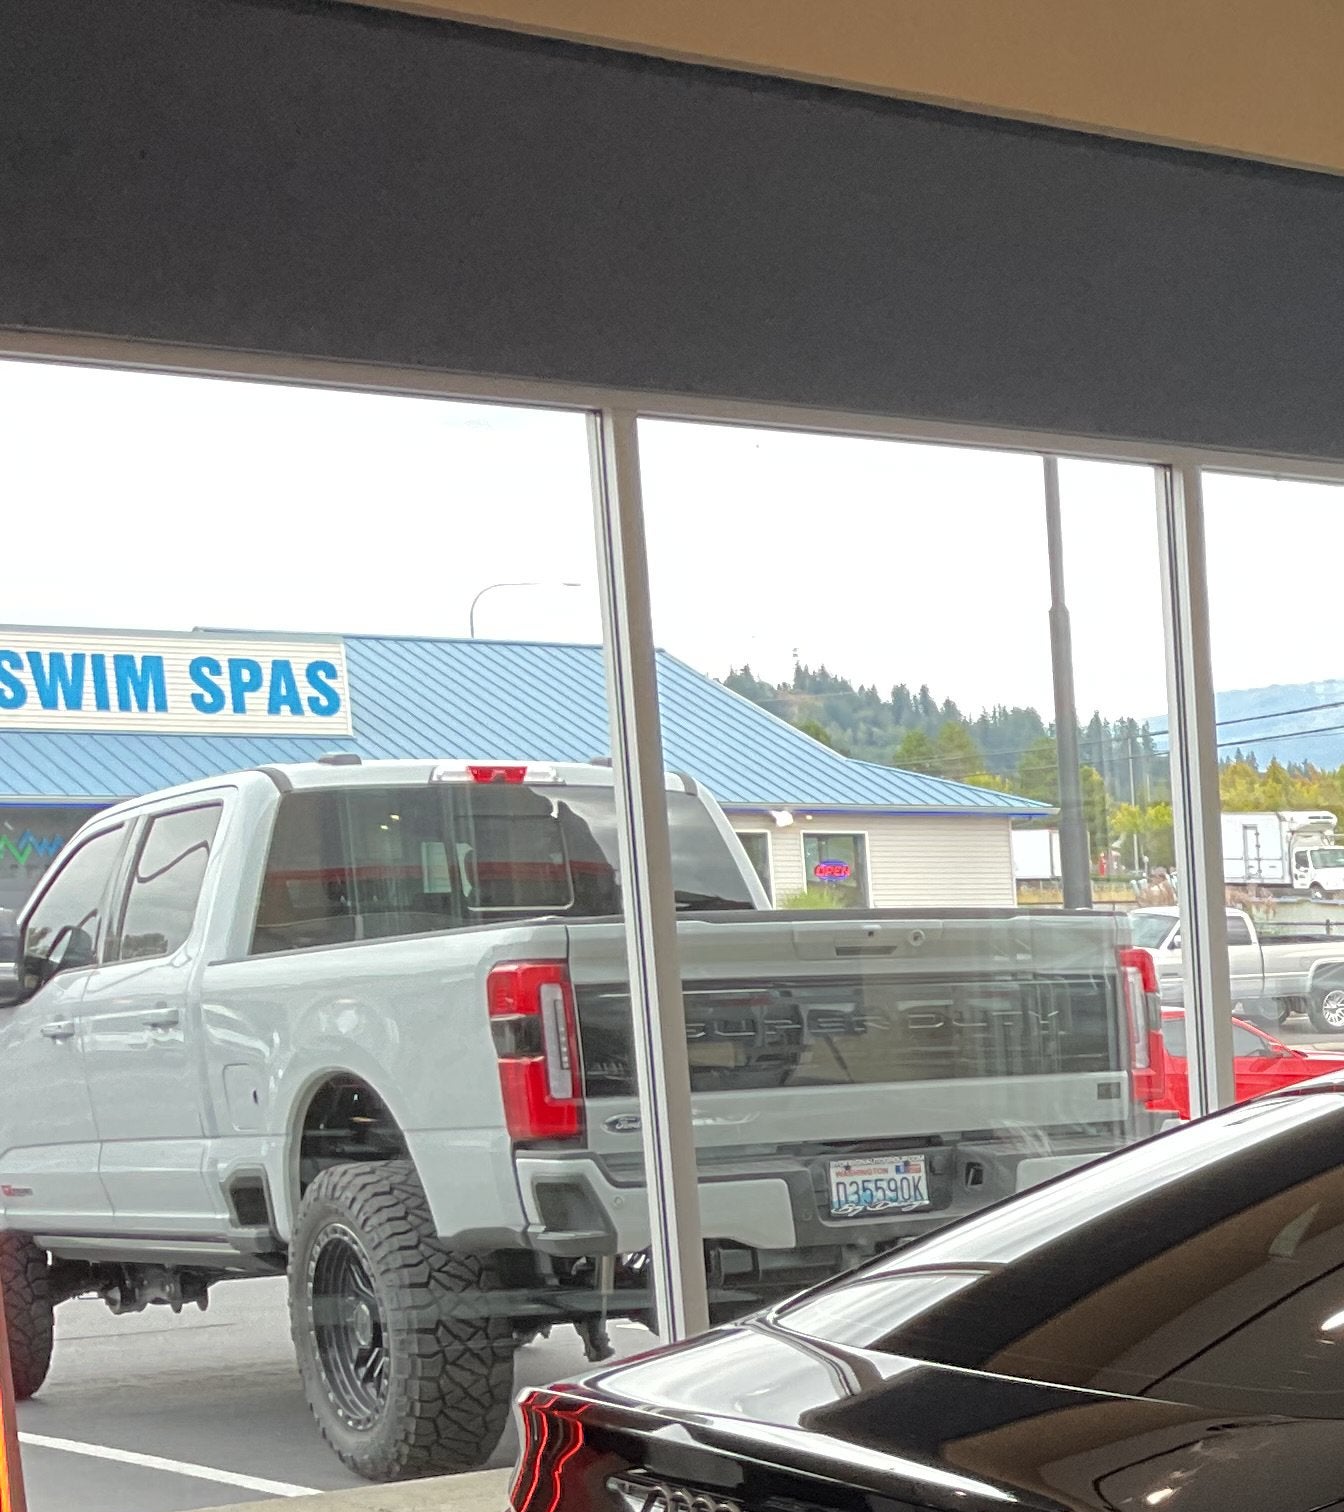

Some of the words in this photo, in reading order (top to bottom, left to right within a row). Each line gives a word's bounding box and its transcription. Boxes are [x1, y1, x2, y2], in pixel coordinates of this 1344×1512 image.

[0, 650, 168, 712] SWIM
[189, 656, 341, 717] SPAS
[814, 864, 850, 877] OPEN
